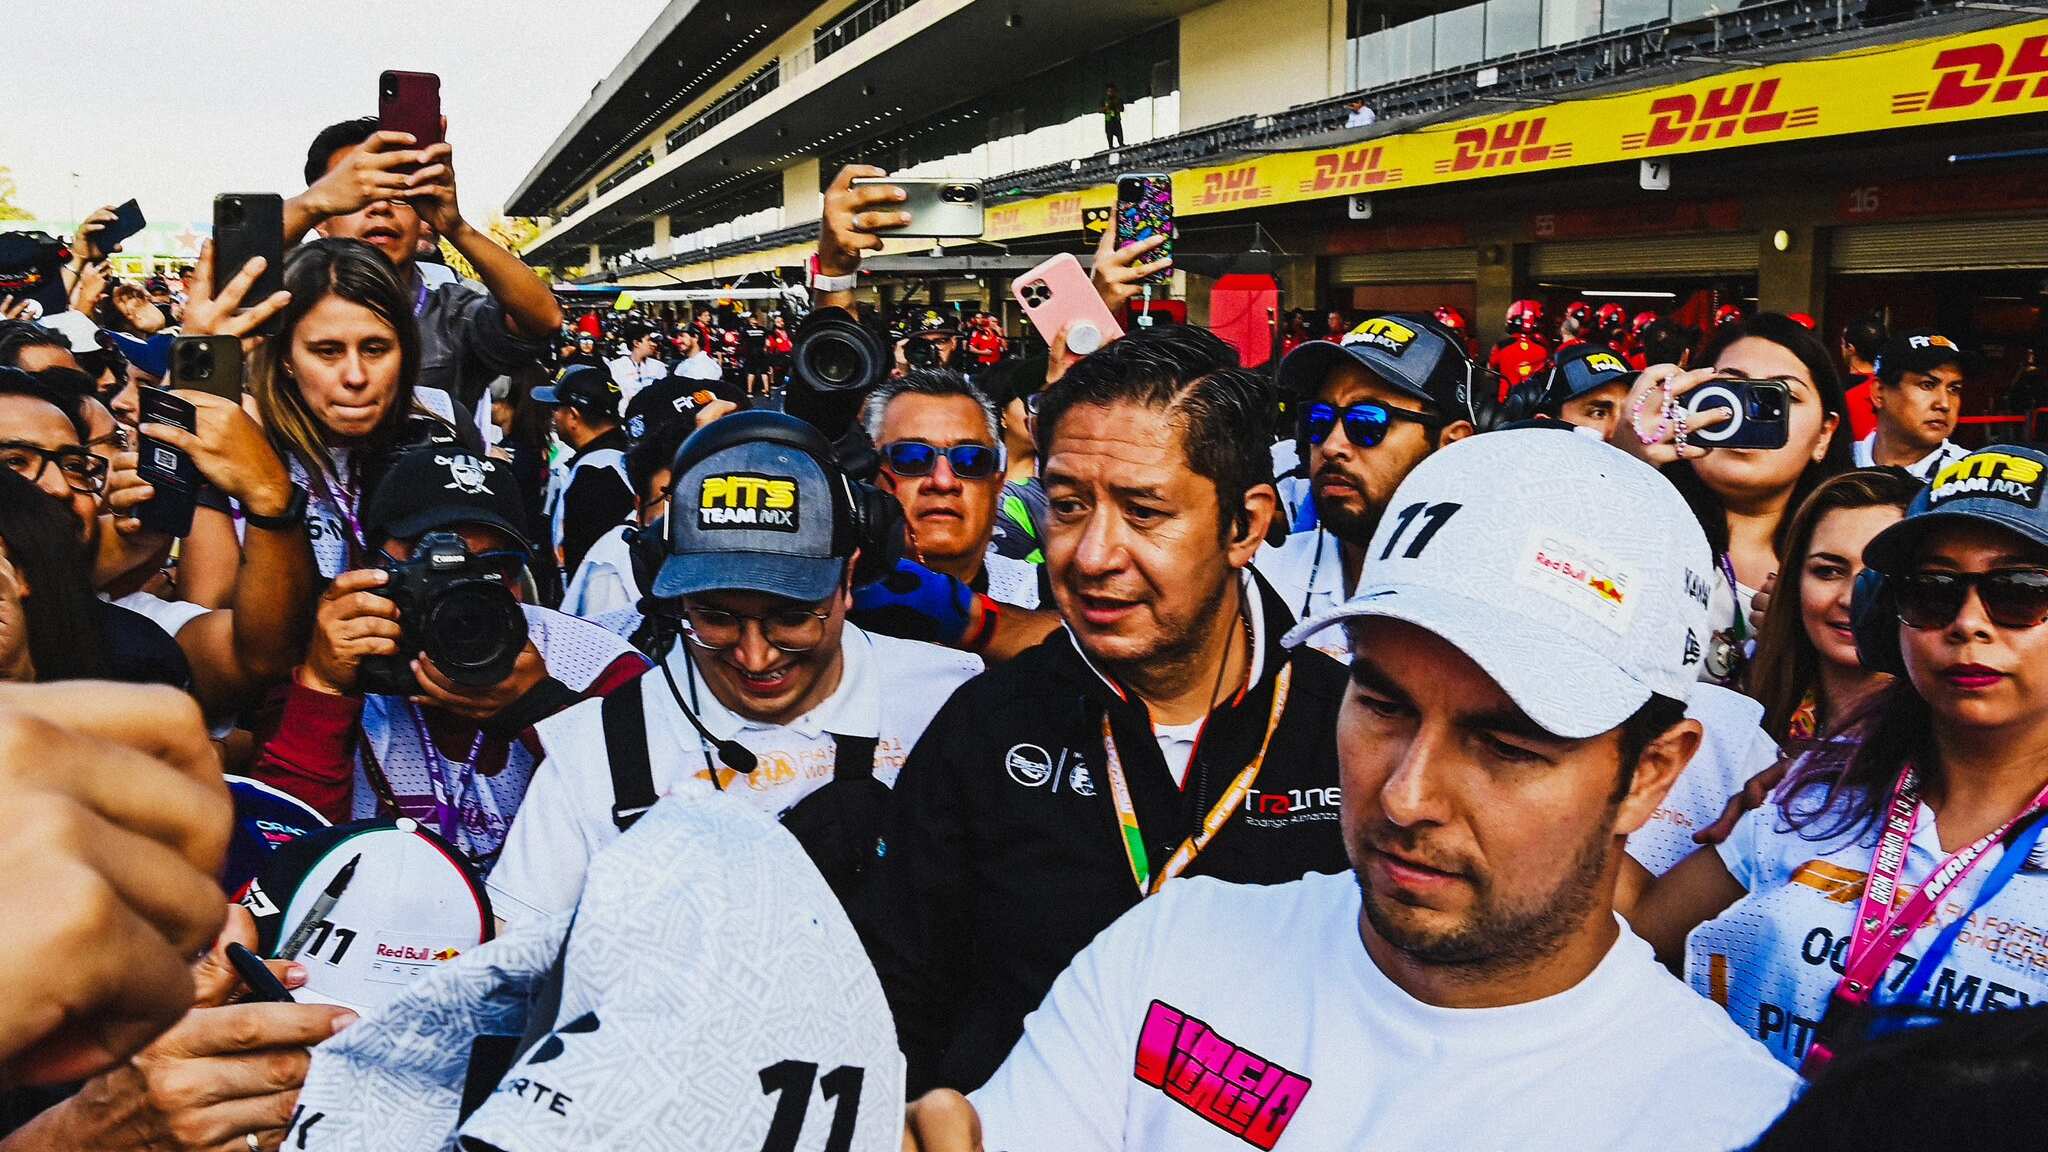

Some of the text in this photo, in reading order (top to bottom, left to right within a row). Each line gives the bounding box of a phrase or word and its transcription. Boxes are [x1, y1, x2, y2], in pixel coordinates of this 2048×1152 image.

[1645, 78, 1788, 147] DHL
[1452, 117, 1551, 172] DHL
[1203, 167, 1260, 206] DHL
[1313, 147, 1387, 191] DHL
[1651, 163, 1660, 179] 7
[1848, 187, 1879, 213] 16
[702, 476, 796, 508] PITS
[700, 508, 794, 527] TEAM MX
[1380, 502, 1463, 560] 11
[1536, 551, 1585, 582] Red Bull
[256, 820, 308, 836] ORAC
[1877, 831, 1905, 876] PREMIO
[305, 919, 357, 966] 11
[376, 943, 430, 960] Red Bull
[758, 1059, 865, 1152] 11
